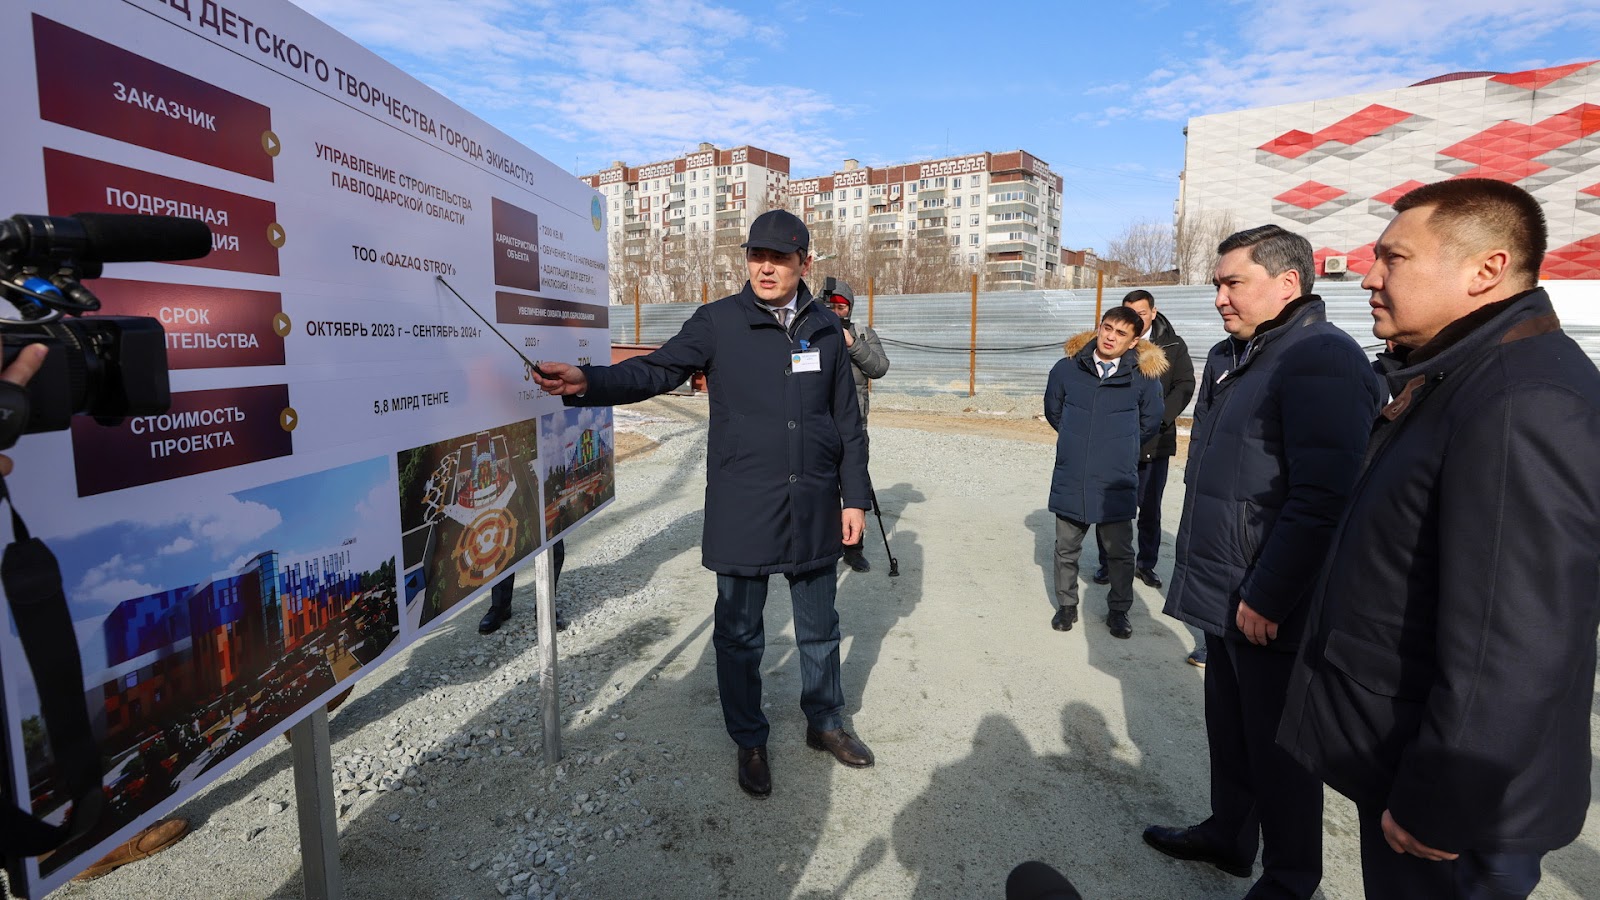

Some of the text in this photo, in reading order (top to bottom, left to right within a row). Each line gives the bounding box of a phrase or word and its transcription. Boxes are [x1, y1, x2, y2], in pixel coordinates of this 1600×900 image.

[113, 81, 216, 132] ЗАКАЗЧИК
[199, 0, 534, 186] ДЕТСКОГО ТВОРЧЕСТВА ГОРОДА ЭКИБАСТУЗ
[315, 142, 472, 211] УПРАВЛЕНИЕ СТРОИТЕЛЬСТВА
[106, 187, 228, 226] ПОДРЯДНАЯ
[332, 172, 465, 226] ПАВЛОДАРСКОЙ ОБЛАСТИ
[495, 232, 538, 253] ХАРАКТЕРИСТИКА
[506, 248, 530, 262] ОБЪЕКТА
[352, 245, 456, 276] ТОО «QAZAQ STROY»
[160, 306, 210, 325] СРОК
[306, 321, 368, 338] ОКТЯБРЬ
[371, 322, 396, 338] 2023
[398, 326, 402, 337] г
[412, 326, 459, 338] СЕНТЯБРЬ
[460, 326, 477, 338] 2024
[478, 330, 482, 338] г
[164, 332, 259, 349] ТЕЛЬСТВА
[525, 337, 536, 347] 2023
[374, 392, 449, 415] 5,8 МЛРД ТЕНГЕ
[130, 406, 246, 435] СТОИМОСТЬ
[150, 430, 235, 459] ПРОЕКТА
